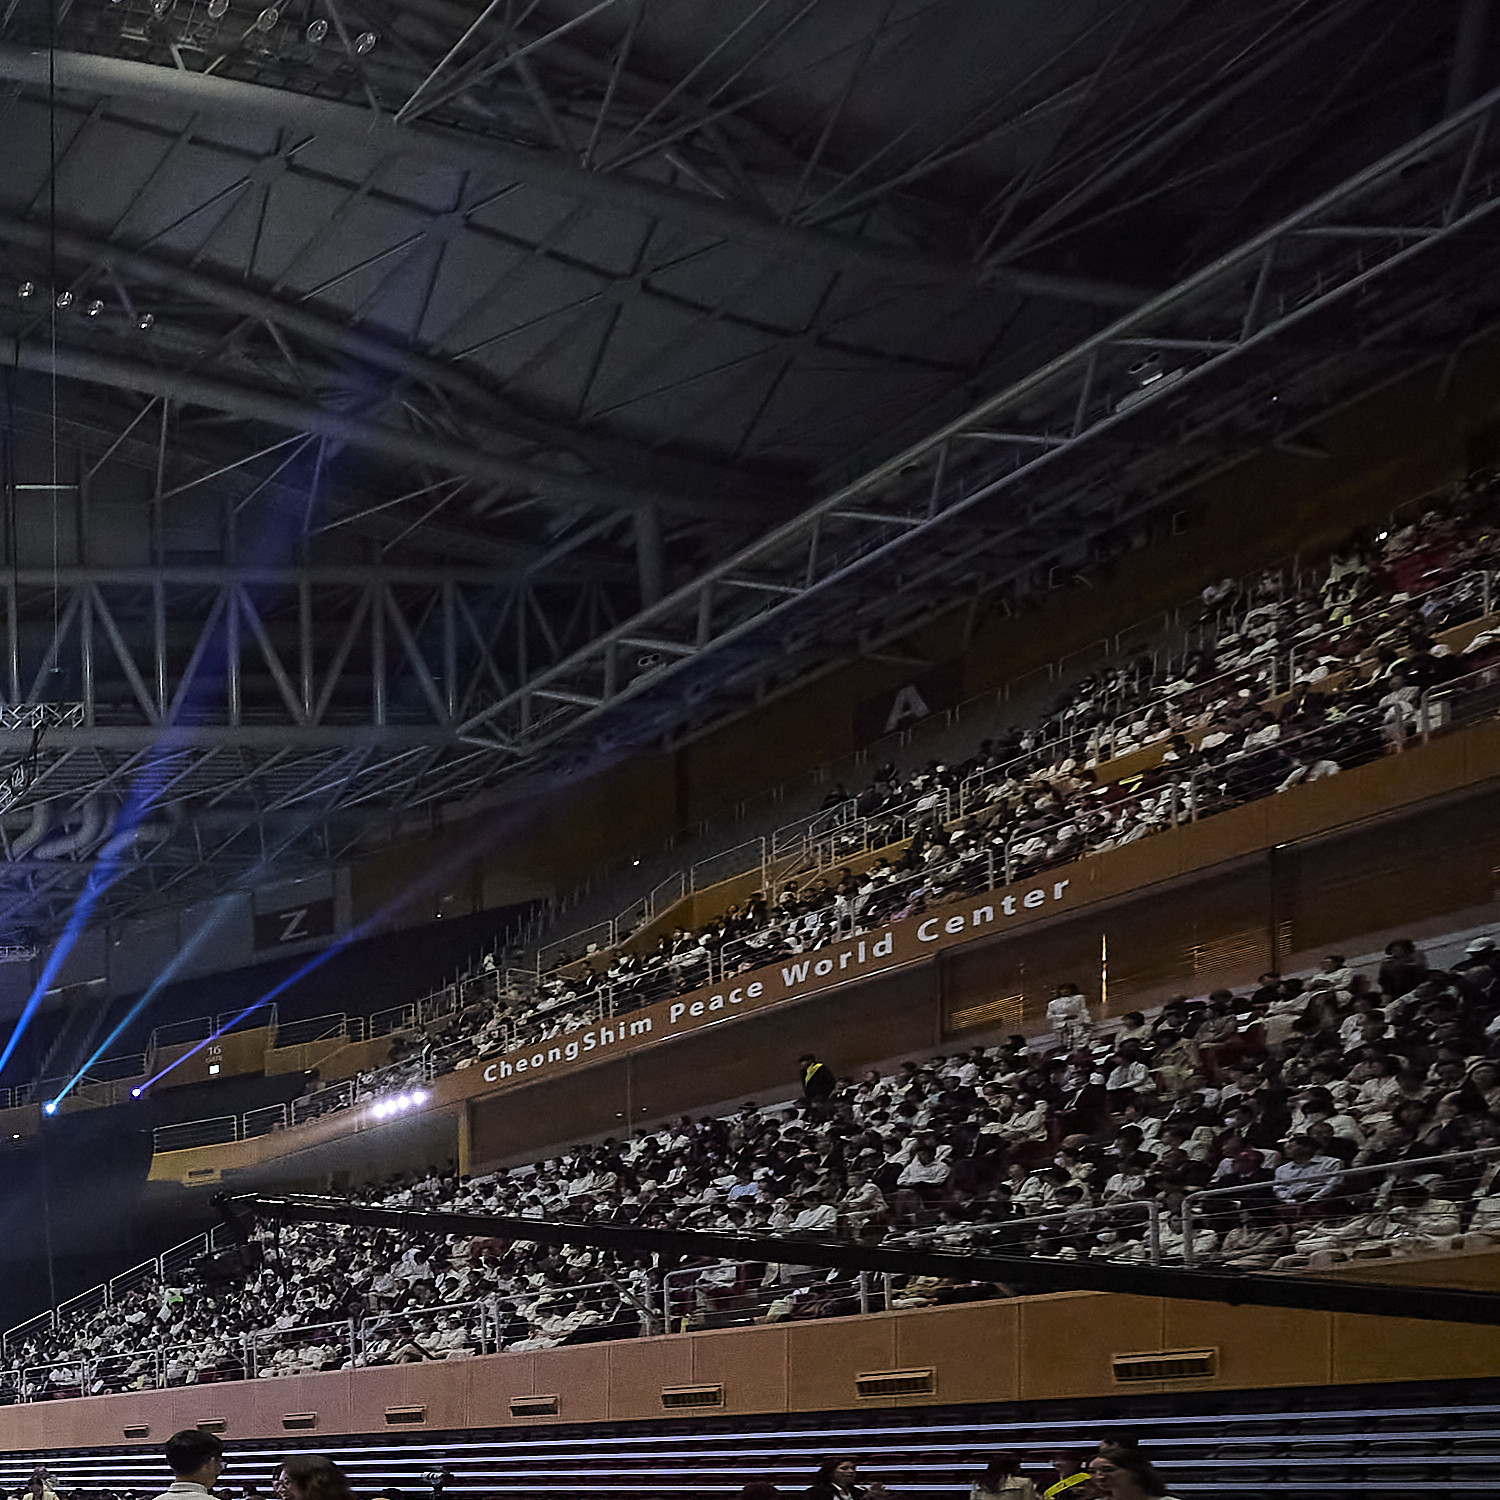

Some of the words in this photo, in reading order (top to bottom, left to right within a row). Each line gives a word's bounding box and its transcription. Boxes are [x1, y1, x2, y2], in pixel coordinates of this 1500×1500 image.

[883, 684, 931, 734] A
[279, 909, 308, 941] Z
[483, 1016, 653, 1083] CheongShim
[670, 980, 764, 1024] Peace
[781, 931, 893, 988] World
[916, 879, 1070, 942] Center
[208, 1045, 222, 1056] 16
